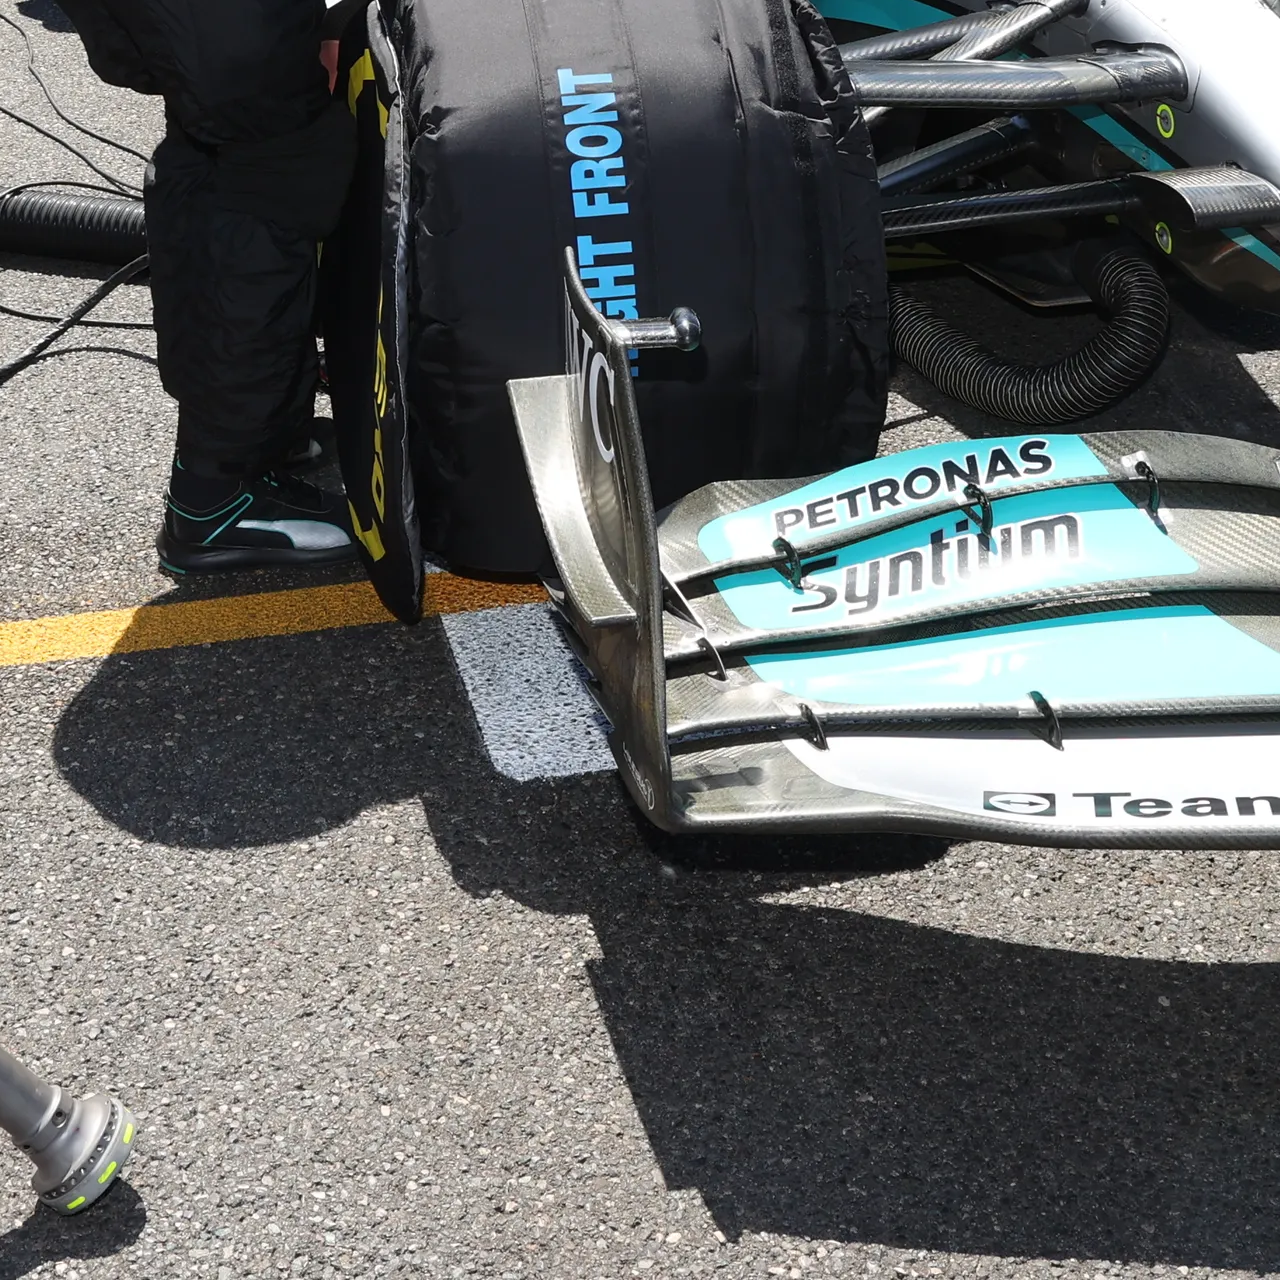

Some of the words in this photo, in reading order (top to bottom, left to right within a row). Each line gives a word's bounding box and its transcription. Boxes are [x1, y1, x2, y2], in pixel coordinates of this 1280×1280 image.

[557, 68, 630, 218] FRONT
[775, 440, 1053, 537] PETRONAS
[790, 512, 1080, 619] Syntium
